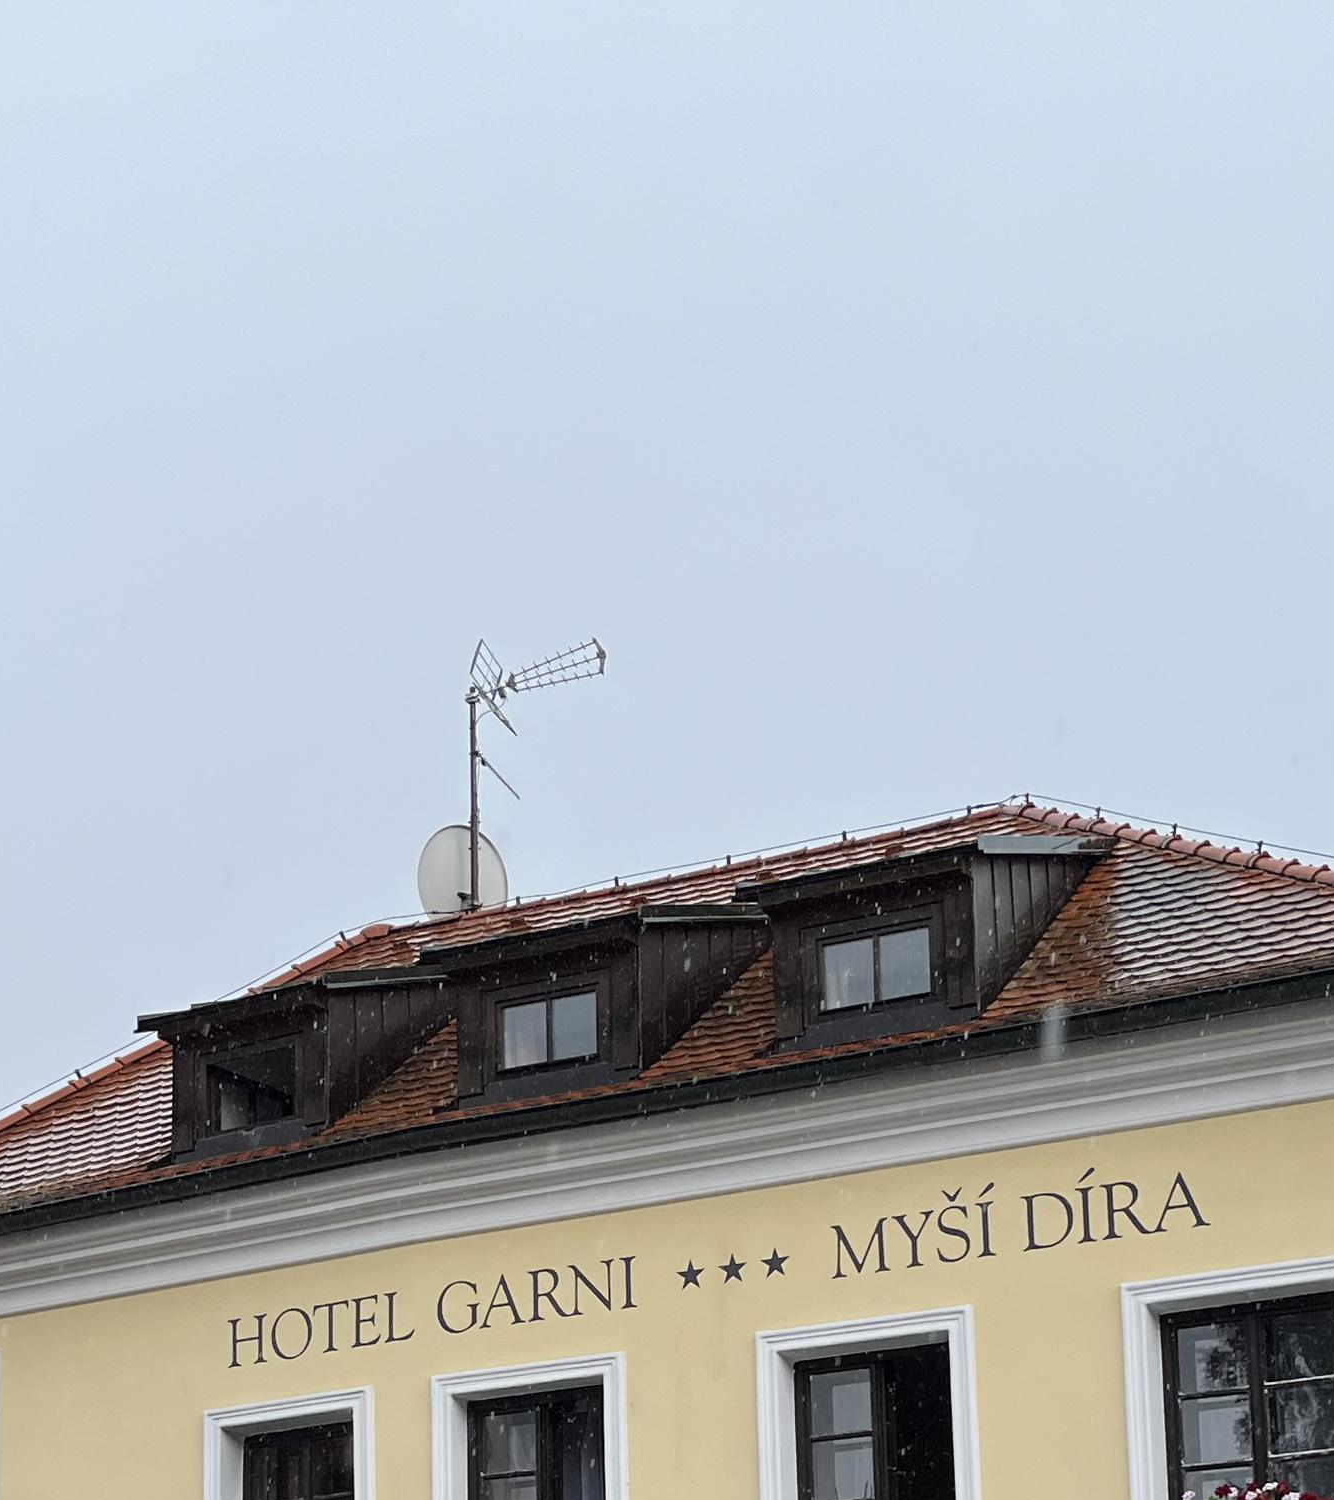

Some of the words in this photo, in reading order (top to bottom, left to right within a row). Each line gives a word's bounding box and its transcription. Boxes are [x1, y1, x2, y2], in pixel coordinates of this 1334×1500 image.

[229, 1291, 414, 1368] HOTEL
[437, 1255, 640, 1334] GARNI
[830, 1182, 996, 1280] MYŠÍ
[1023, 1167, 1211, 1252] DÍRA
